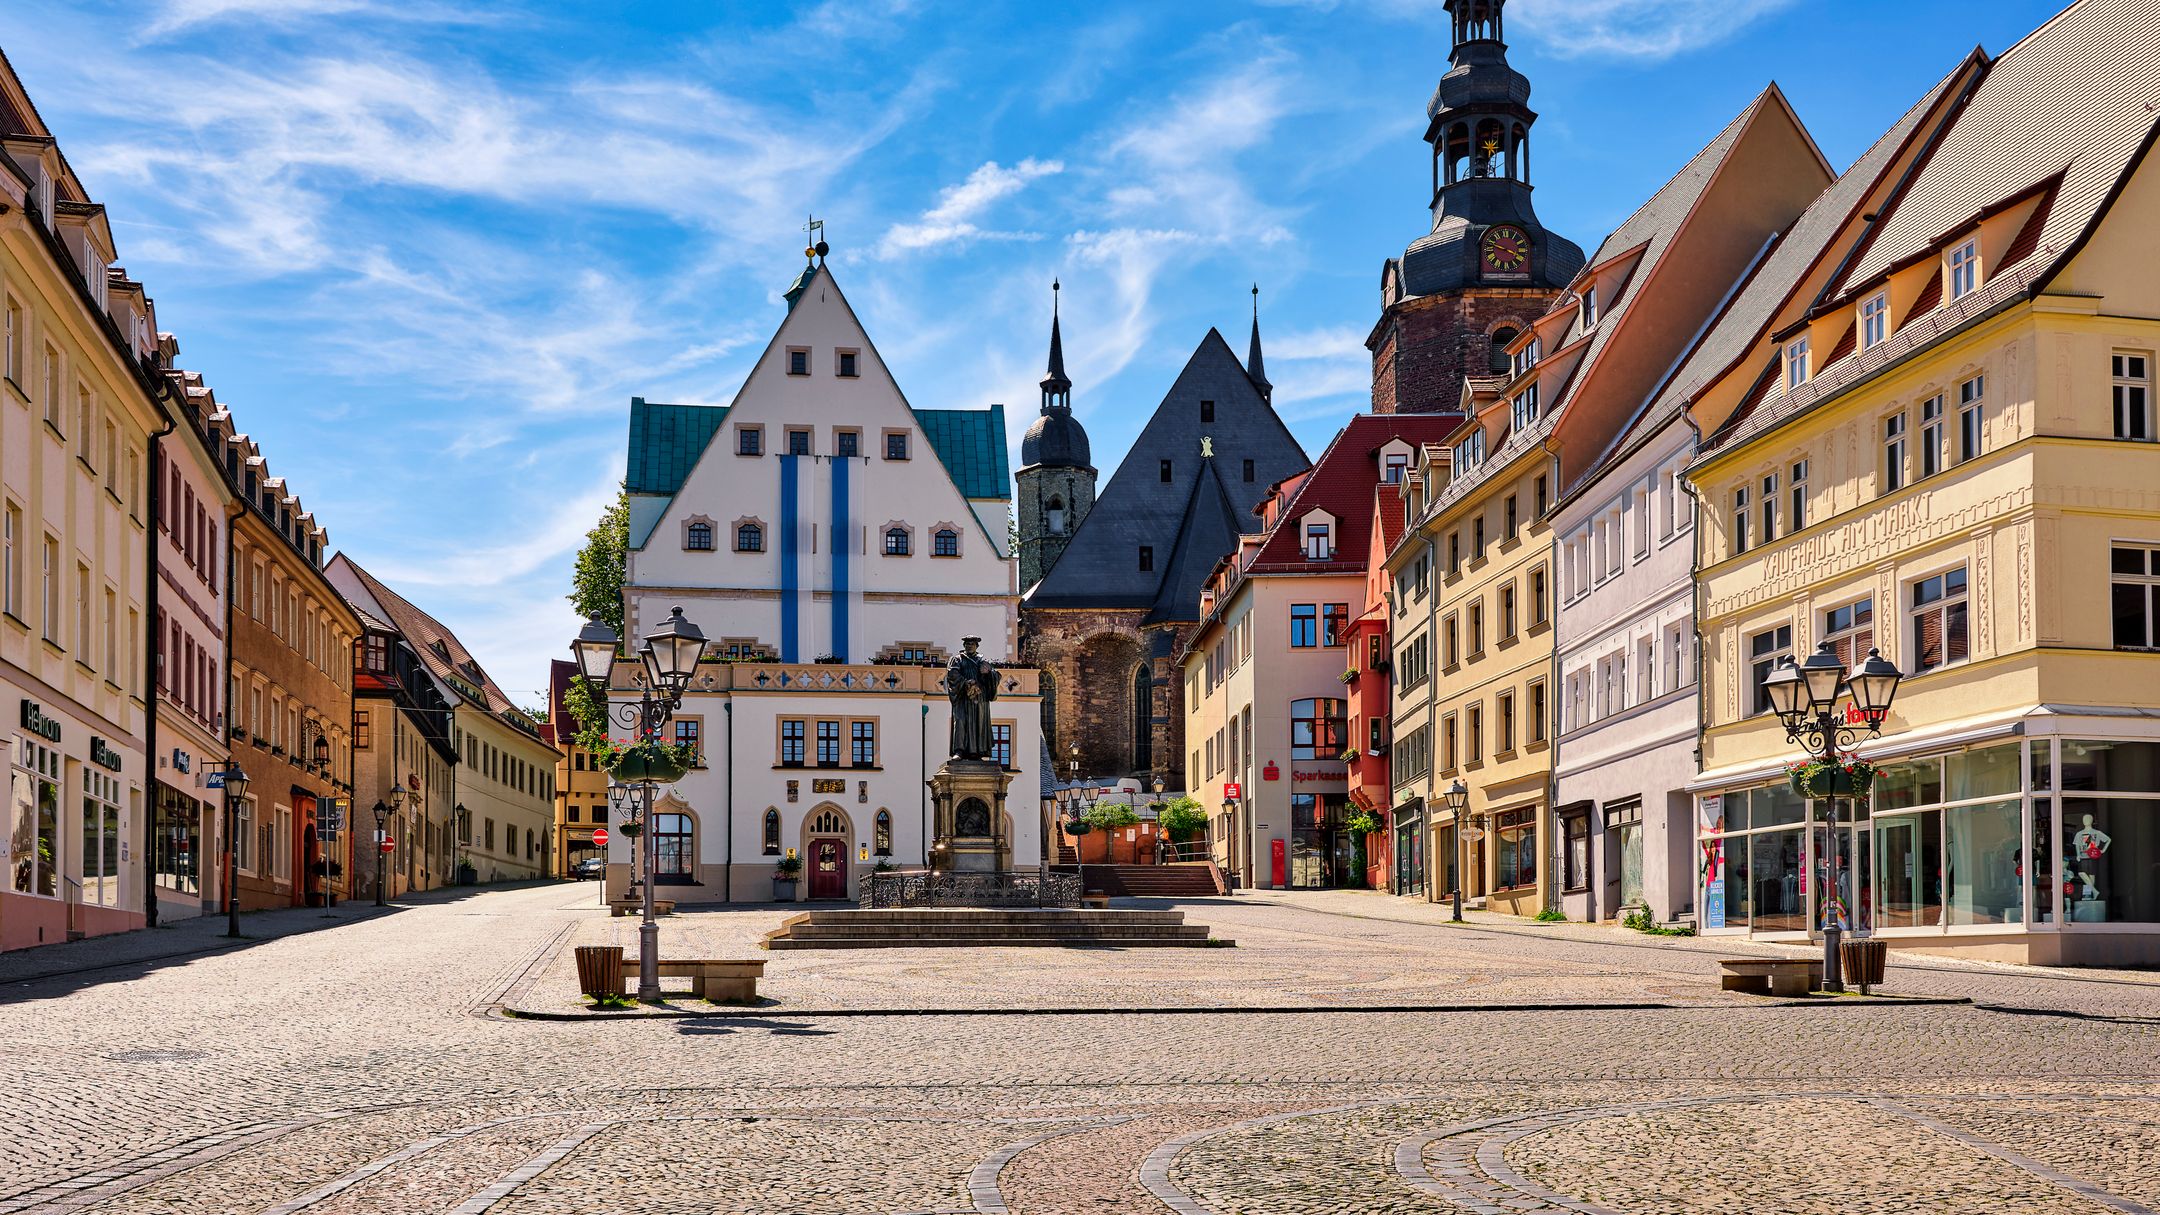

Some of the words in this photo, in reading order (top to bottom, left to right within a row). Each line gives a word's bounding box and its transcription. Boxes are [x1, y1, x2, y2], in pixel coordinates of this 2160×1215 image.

[1762, 530, 1836, 582] KAUFHAUS
[1841, 518, 1867, 553] AM
[1873, 491, 1933, 541] MARKT
